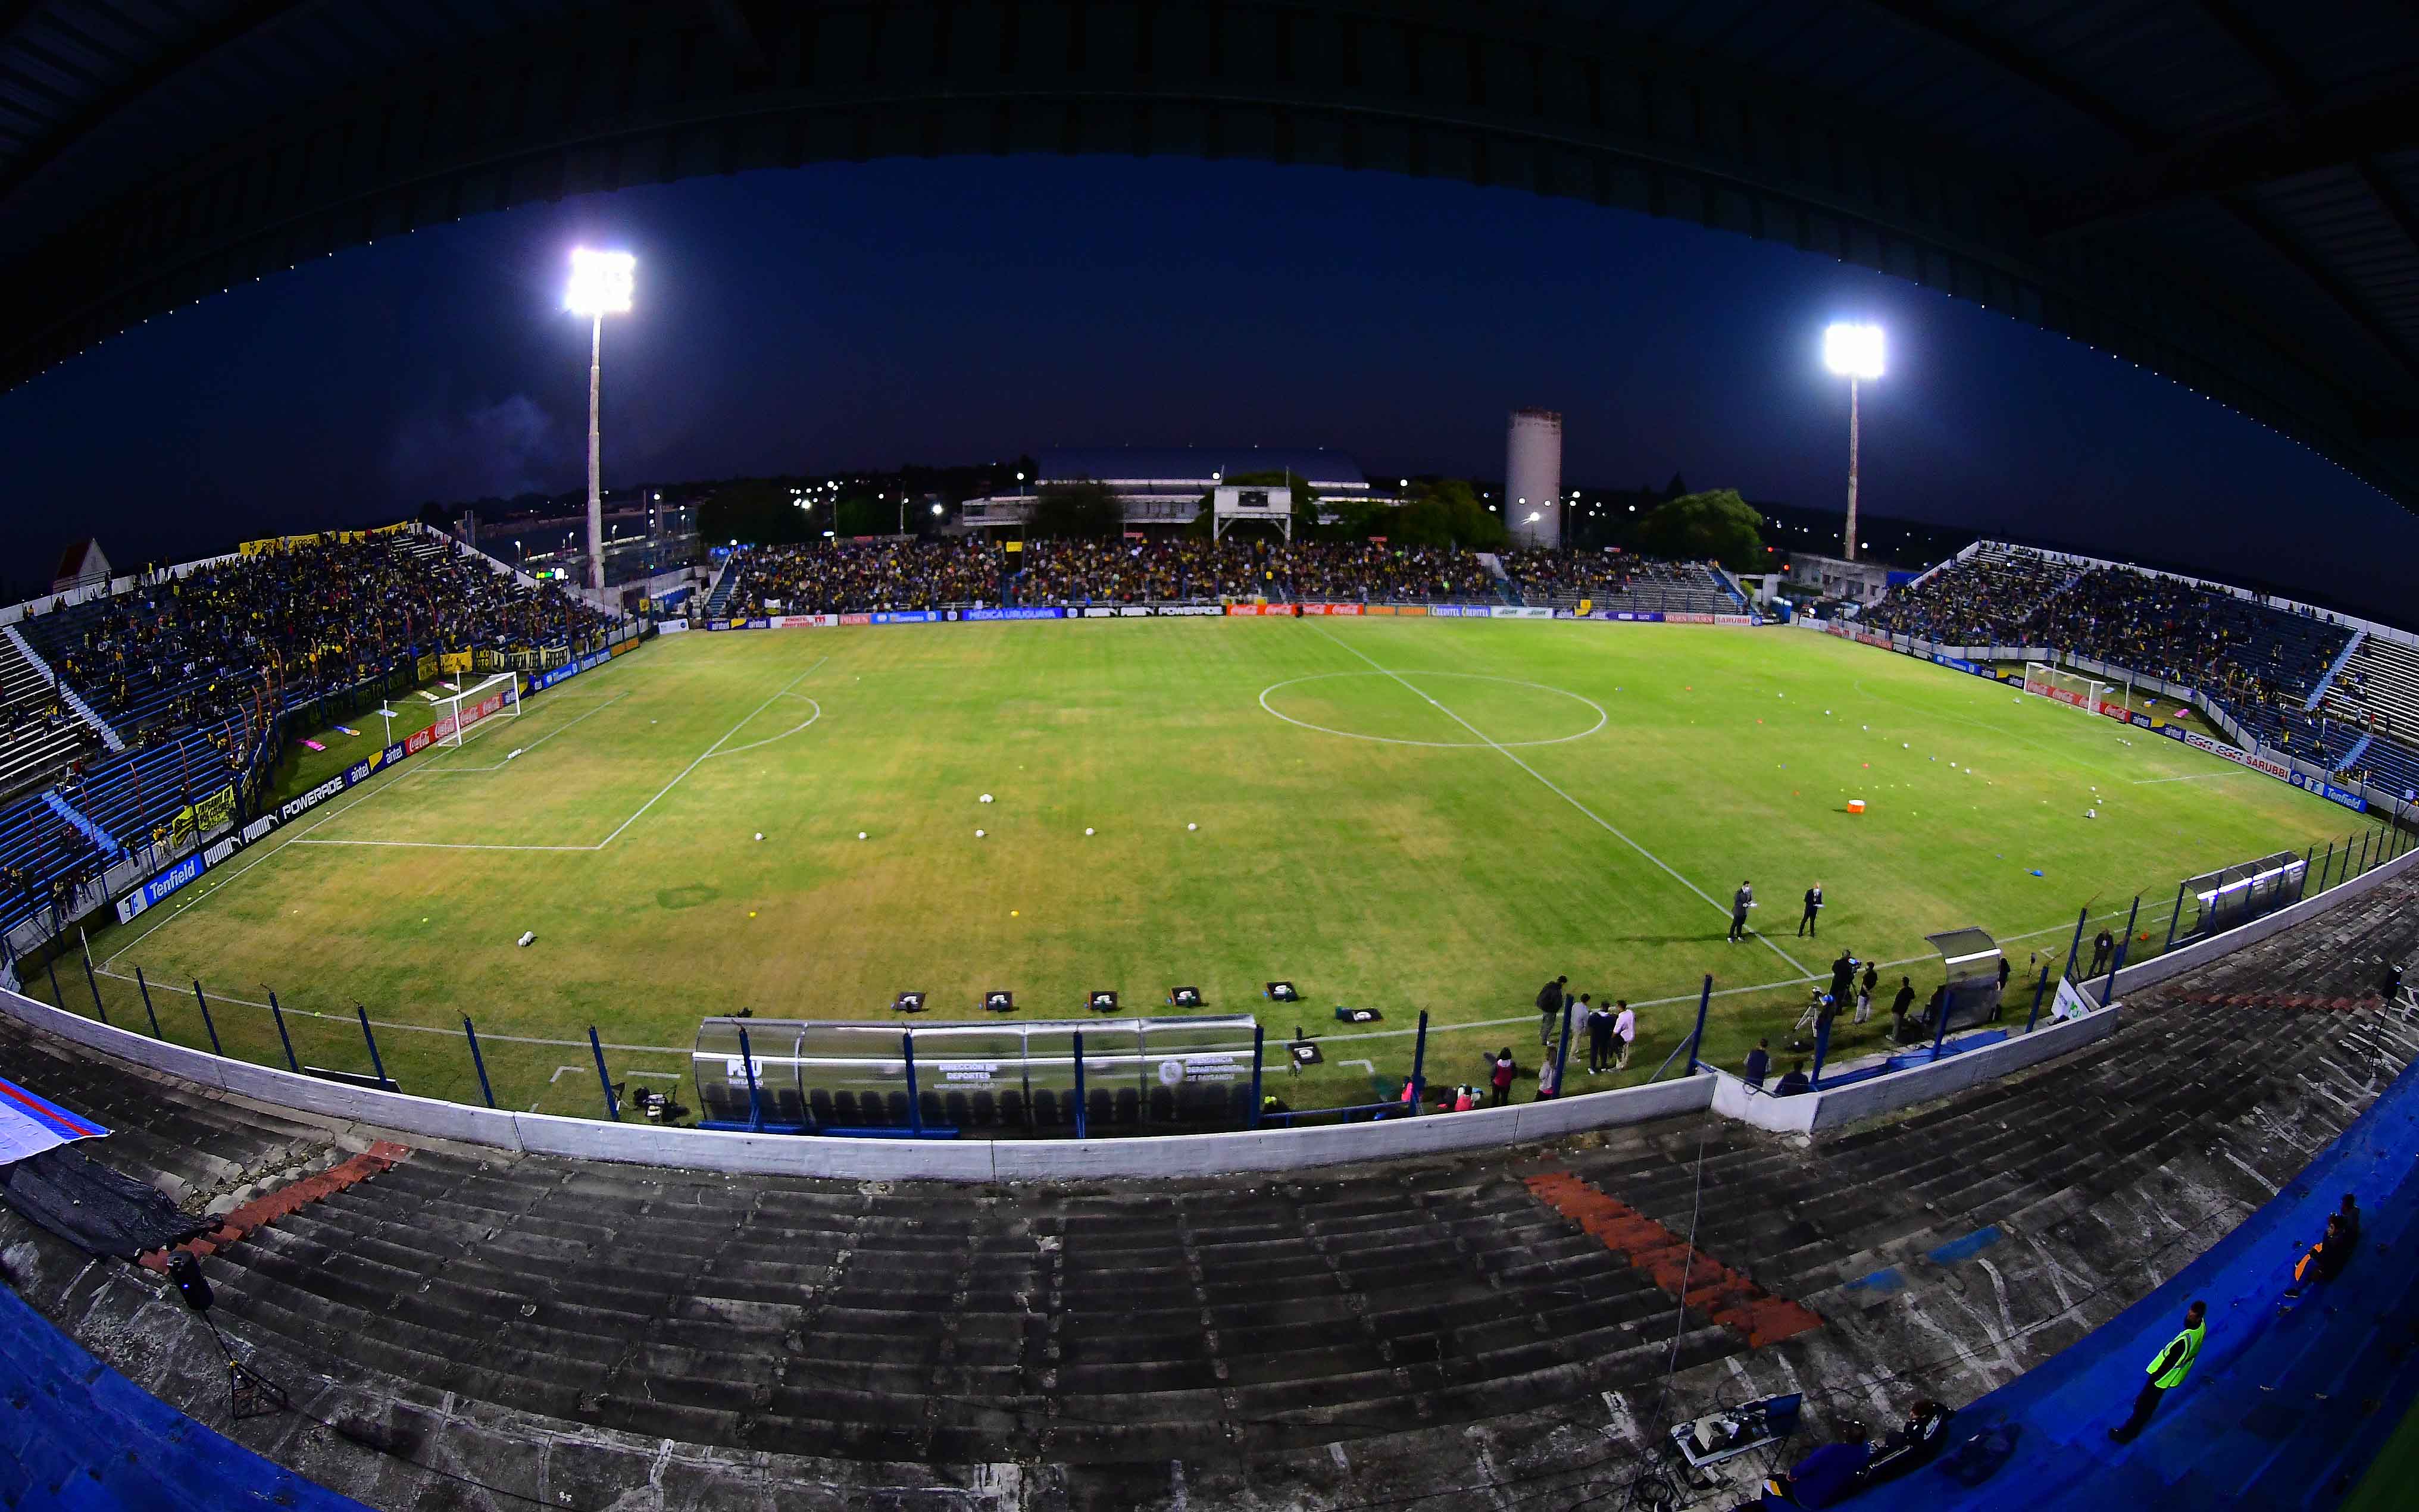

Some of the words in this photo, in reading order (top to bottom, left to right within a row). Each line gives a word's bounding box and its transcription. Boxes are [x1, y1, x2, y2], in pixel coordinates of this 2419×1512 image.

[386, 746, 402, 763] antel
[351, 763, 369, 782] antel
[2246, 756, 2288, 779] SARUBBI
[282, 776, 343, 819] POWERADE
[2328, 787, 2361, 809] Tenfield
[243, 815, 270, 843] PUMA
[204, 838, 233, 868] PUMA
[149, 860, 195, 899] Tenfield
